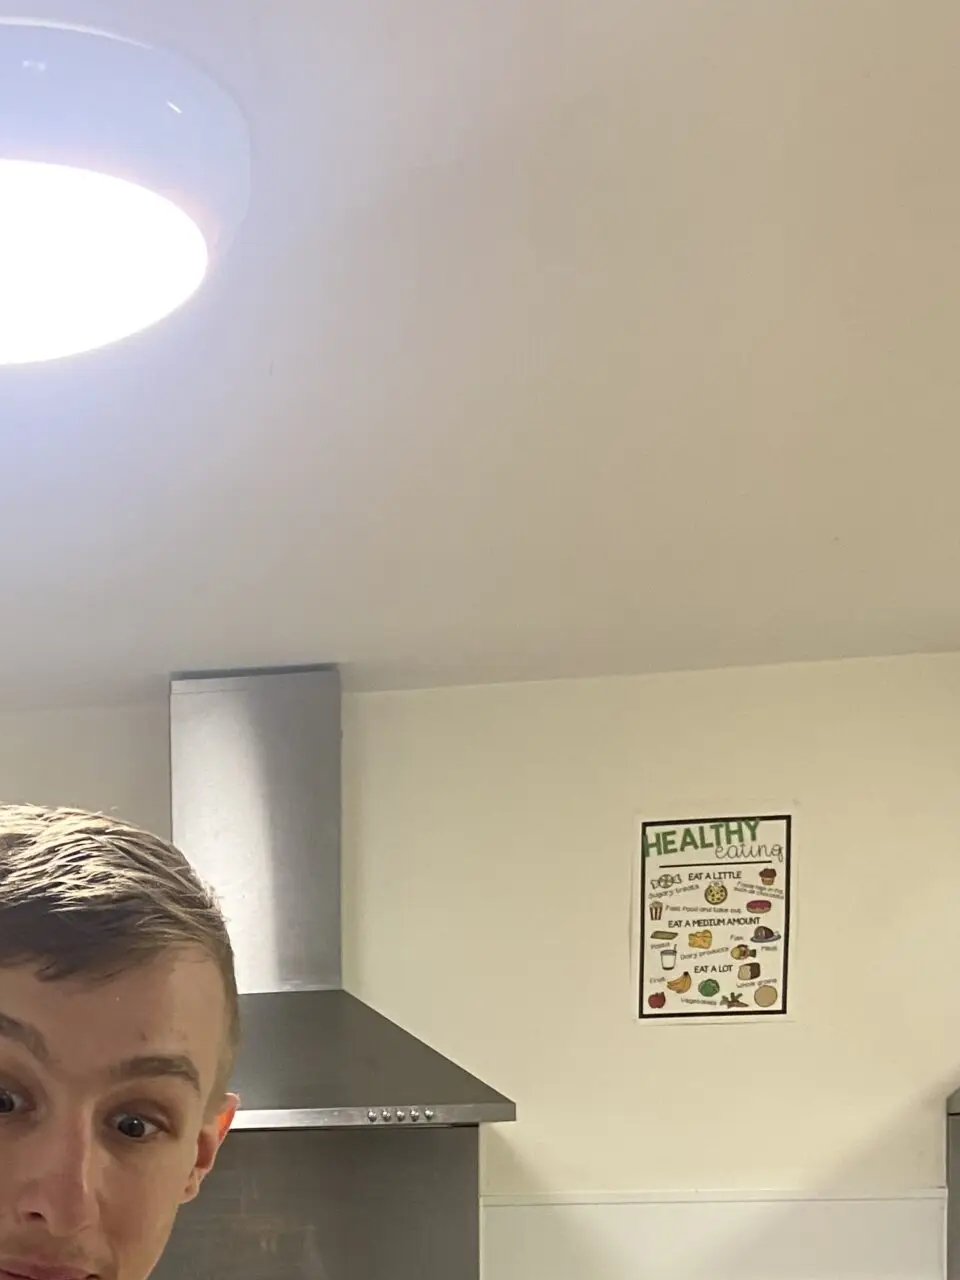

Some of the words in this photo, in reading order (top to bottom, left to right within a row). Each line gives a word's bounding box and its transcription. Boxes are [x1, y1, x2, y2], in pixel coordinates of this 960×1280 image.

[644, 818, 760, 857] HEALTHY
[715, 844, 784, 862] eating
[688, 872, 703, 881] EAT
[705, 872, 712, 880] A
[713, 870, 742, 880] LITTLE
[668, 920, 682, 928] EAT
[685, 920, 691, 928] A
[692, 918, 725, 927] MEDIUM
[726, 917, 761, 926] AMOUNT
[694, 965, 708, 973] EAT
[711, 965, 717, 973] A
[718, 964, 733, 973] LOT
